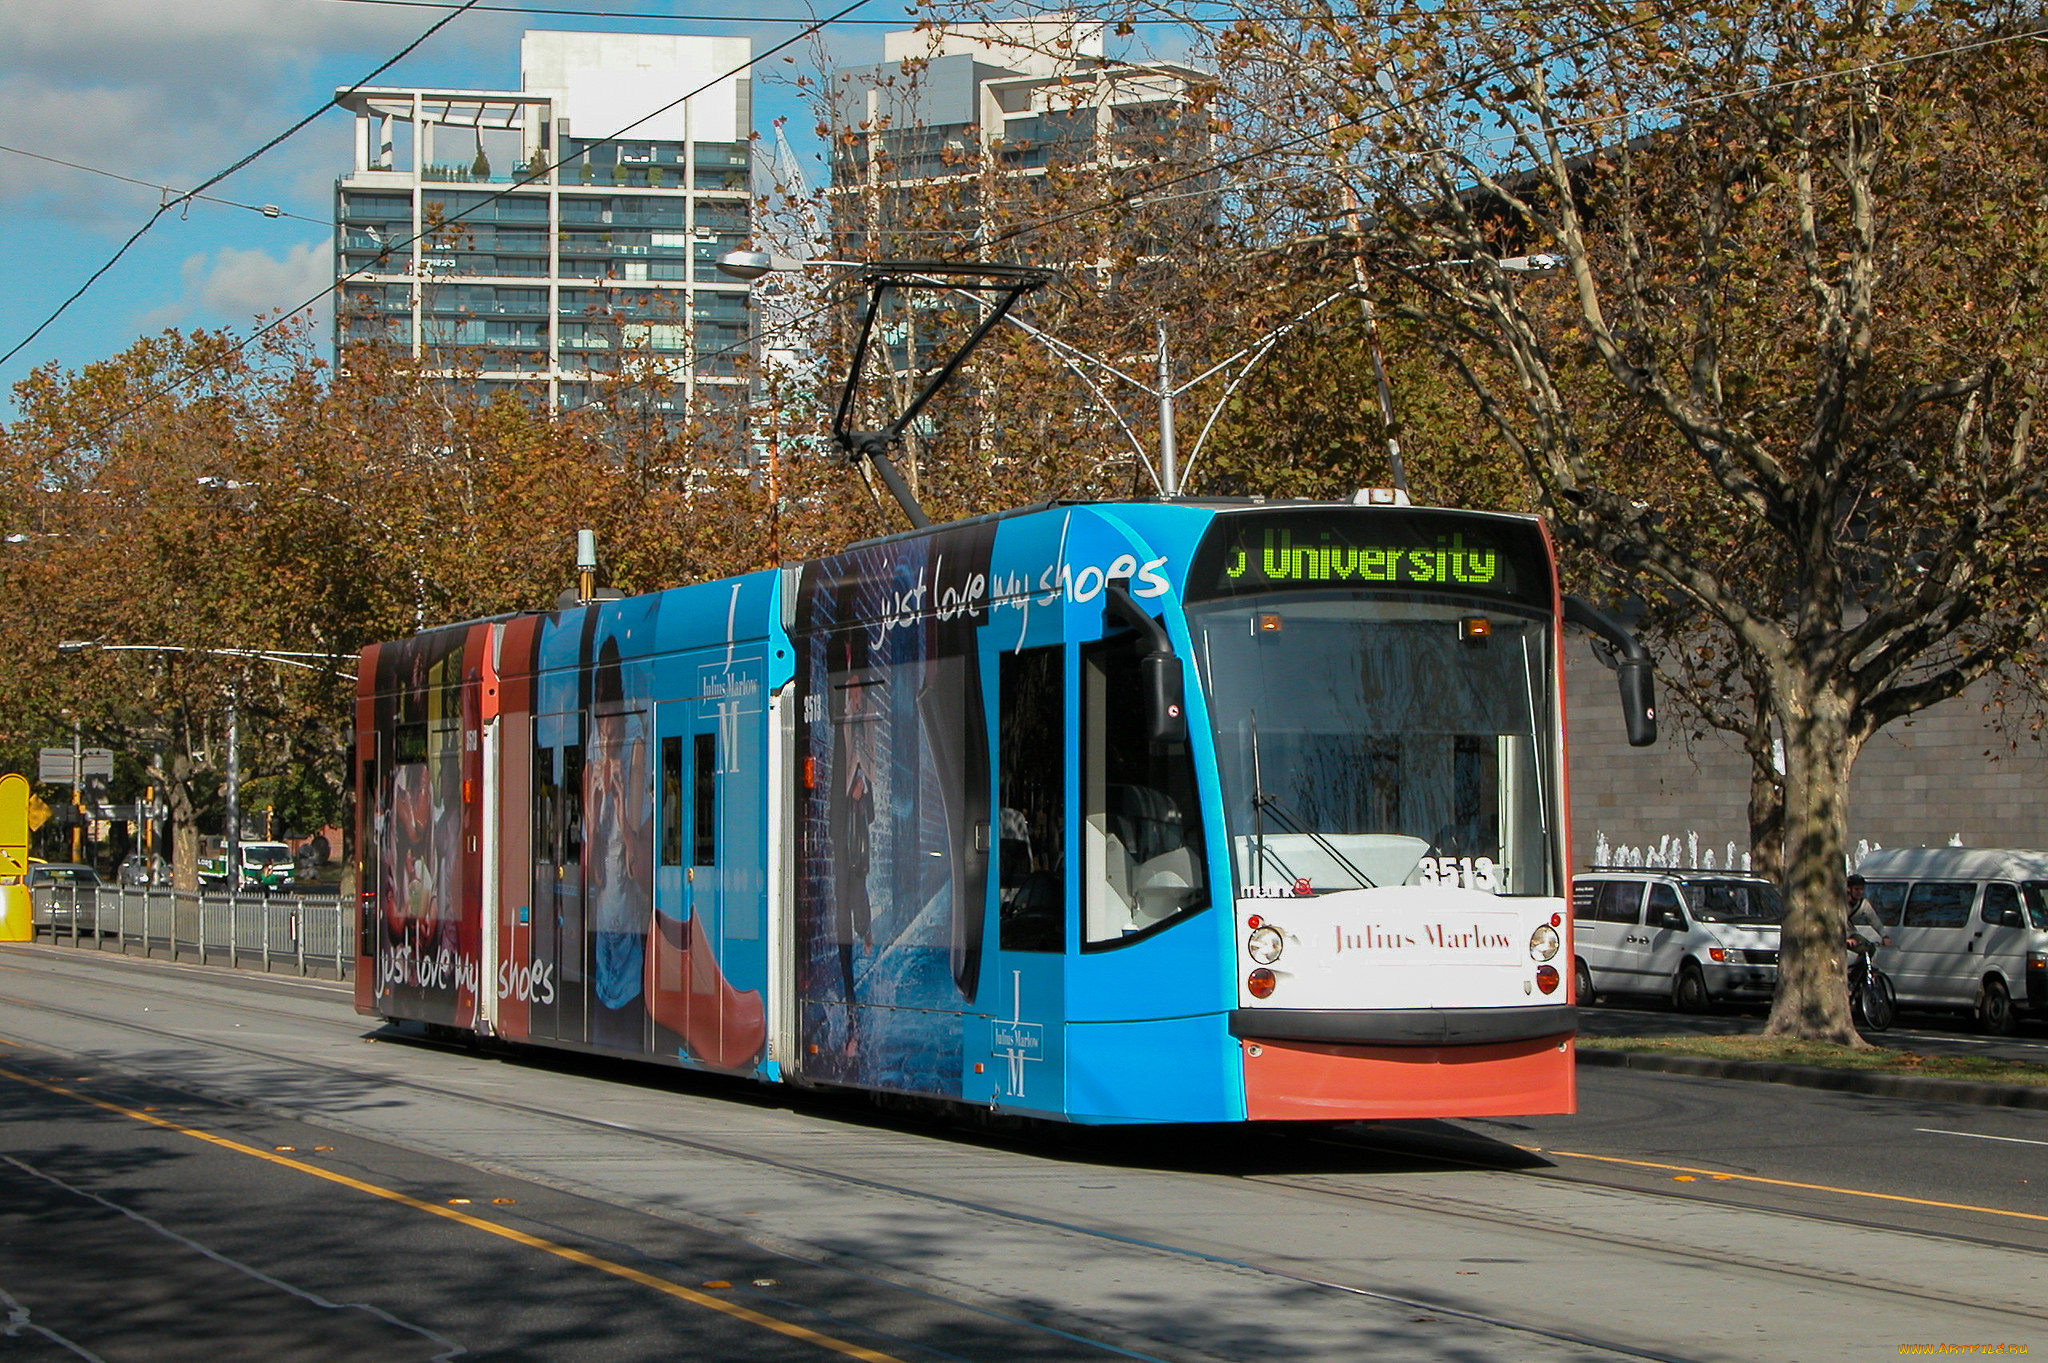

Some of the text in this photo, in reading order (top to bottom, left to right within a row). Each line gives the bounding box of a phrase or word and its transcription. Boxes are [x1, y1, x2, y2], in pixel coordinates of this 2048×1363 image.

[1263, 528, 1496, 583] University
[870, 509, 1170, 655] just love my shoes
[804, 694, 821, 723] 3513
[1419, 857, 1495, 890] 3513
[1335, 923, 1511, 953] Julius Marlow
[375, 907, 555, 1029] just love my shoes
